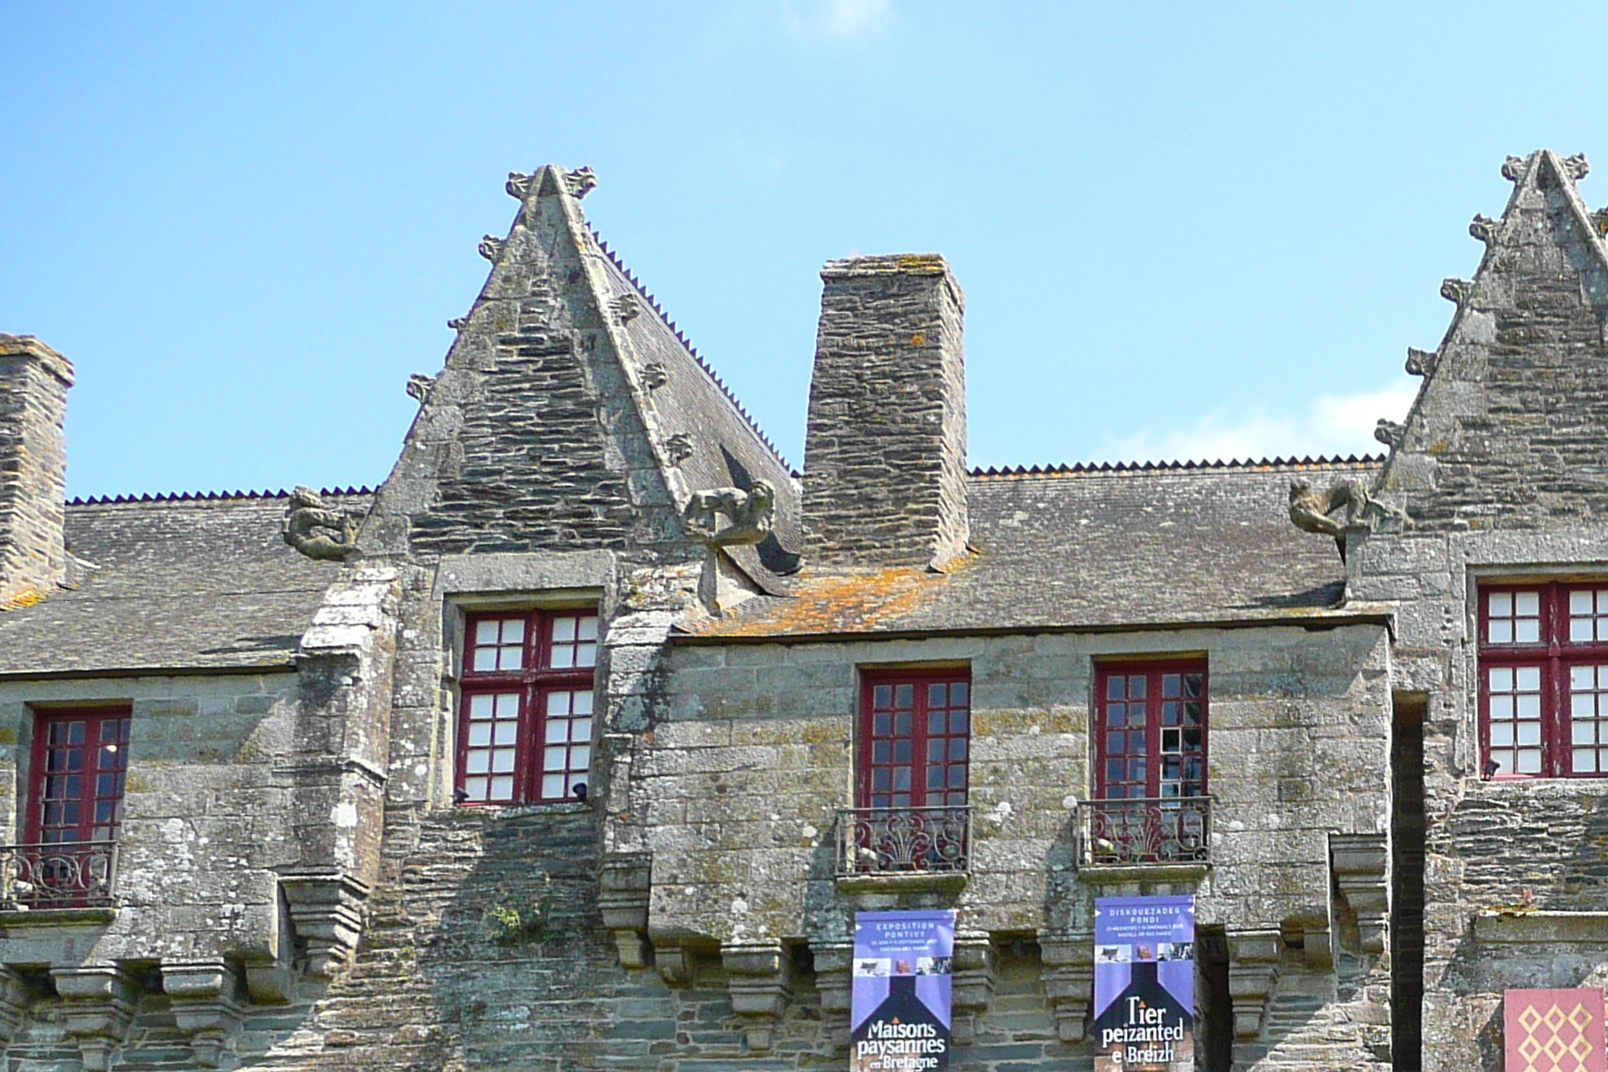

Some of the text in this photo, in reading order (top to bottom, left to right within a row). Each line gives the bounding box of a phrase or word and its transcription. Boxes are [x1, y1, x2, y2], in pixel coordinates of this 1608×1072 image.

[1109, 907, 1181, 917] DISKOUEZADEG
[1130, 916, 1159, 924] PONDI
[876, 922, 934, 931] EXPOSITION
[884, 931, 925, 939] PONTIVY
[1126, 996, 1167, 1025] Tier
[867, 1019, 936, 1039] Maisons
[1102, 1017, 1184, 1048] peizanted
[857, 1039, 946, 1060] paysannes
[1112, 1041, 1174, 1064] e Breizh
[869, 1055, 938, 1072] en Bretagne
